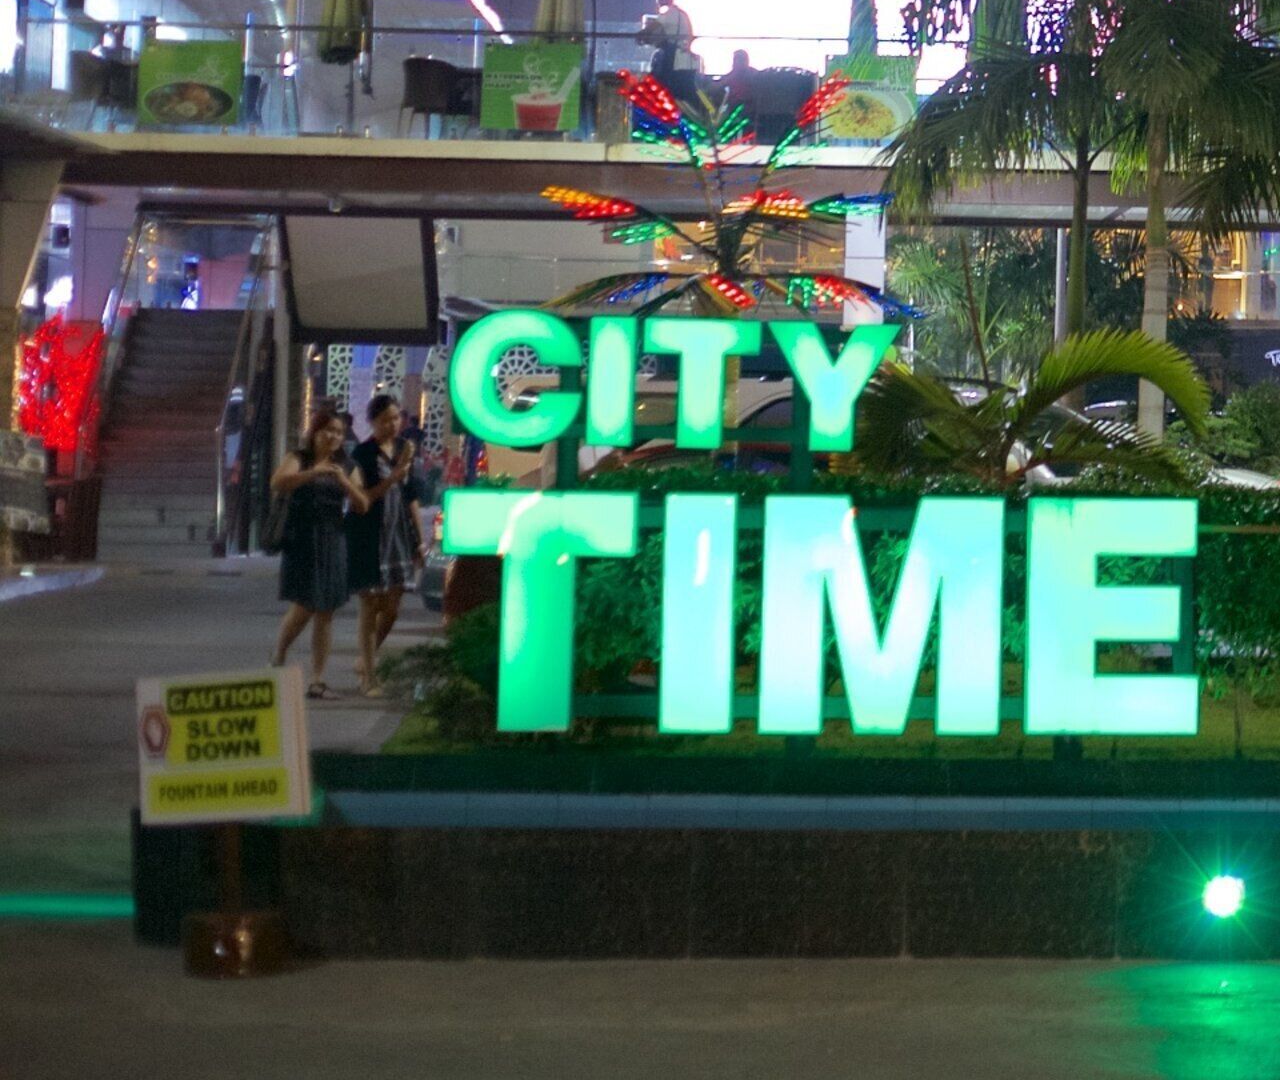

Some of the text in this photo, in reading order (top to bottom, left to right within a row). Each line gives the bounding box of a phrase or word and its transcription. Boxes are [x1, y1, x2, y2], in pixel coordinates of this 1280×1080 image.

[449, 307, 901, 452] CITY
[442, 489, 1200, 736] TIME
[170, 685, 272, 712] CAUTION
[187, 715, 258, 739] SLOW
[185, 738, 262, 762] DOWN
[158, 778, 278, 802] FOUNTAIN AHEAD
